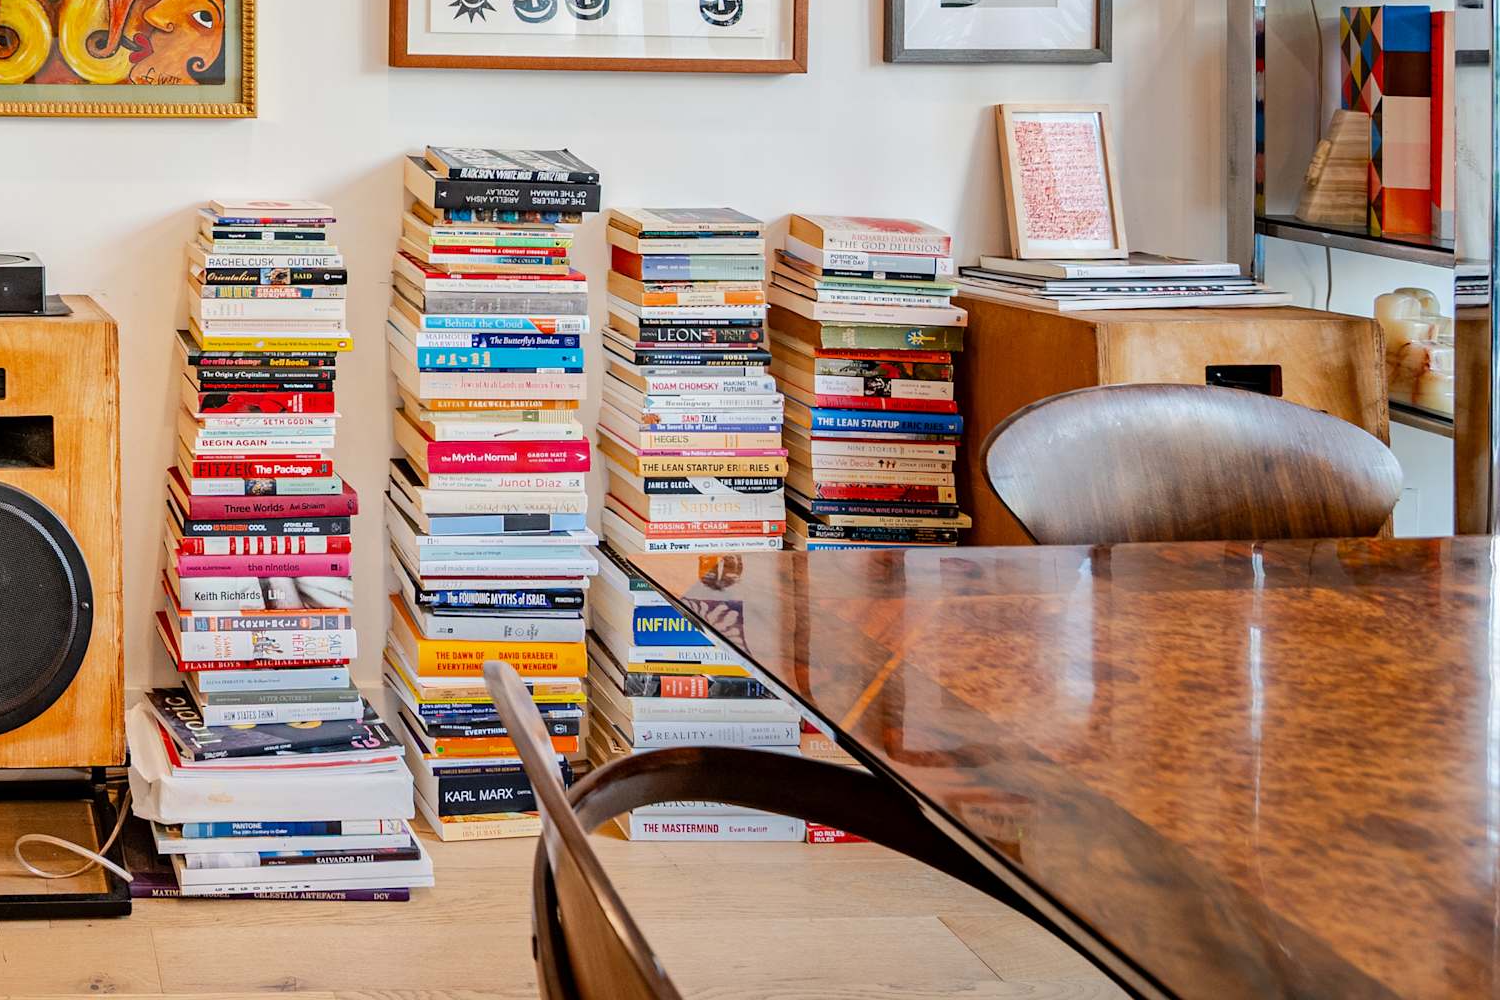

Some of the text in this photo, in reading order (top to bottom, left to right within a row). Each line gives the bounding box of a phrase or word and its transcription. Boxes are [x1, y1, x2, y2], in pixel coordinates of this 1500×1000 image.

[460, 168, 476, 178] BLACK
[494, 170, 517, 180] WHITE
[530, 189, 558, 197] UMMAH
[487, 196, 519, 204] ARIELLA
[839, 240, 941, 252] THE GOD DELUSION
[209, 257, 329, 267] RACHEL CUSK OUTLINE
[207, 270, 313, 282] Orientalism SAID
[445, 318, 523, 328] Behind the Cloud
[657, 328, 702, 341] LEON
[490, 336, 560, 346] The Butterfly's Burden
[215, 371, 233, 379] Origin
[241, 371, 270, 379] Capitalism
[652, 382, 677, 391] NOAM
[679, 382, 718, 391] CHOMSKY
[682, 415, 717, 423] SAND TALK
[817, 416, 944, 431] THE LEAN STARTUP ERIC RIES
[202, 439, 233, 447] BEGIN
[236, 439, 267, 447] AGAIN
[868, 445, 897, 453] STORIES
[452, 453, 477, 464] Myth
[484, 453, 518, 462] Normal
[817, 458, 875, 468] How We Decide
[199, 462, 313, 476] FITZEK The Package
[642, 463, 770, 472] THE LEAN STARTUP RIES
[498, 478, 531, 488] Junot
[647, 481, 669, 489] JAMES
[224, 504, 251, 513] Three
[253, 503, 284, 512] Worlds
[680, 498, 741, 515] Sapiens
[193, 524, 213, 532] GOOD
[248, 524, 267, 532] COOL
[649, 522, 728, 530] CROSSING THE CHASM
[649, 542, 668, 551] Black
[670, 542, 690, 550] Power
[248, 564, 300, 572] the nineties
[194, 590, 218, 601] Keith
[220, 590, 261, 601] Richards
[447, 592, 458, 604] The
[459, 592, 490, 605] FOUNDING
[490, 592, 518, 605] MYTHS
[518, 592, 525, 604] of
[526, 593, 547, 605] ISRAEL
[232, 618, 298, 629] BASKETBALL
[636, 617, 698, 633] INFINIT
[436, 652, 554, 660] THE DAWN OF DAVID GRAEBER
[185, 662, 215, 671] FLASH
[218, 661, 241, 669] BOYS
[256, 659, 299, 667] MICHAEL
[522, 663, 558, 671] WENGROW
[223, 712, 236, 721] HOW
[258, 710, 274, 719] THINK
[464, 727, 508, 736] EVERYTHING
[444, 789, 514, 803] KARL MARX
[232, 822, 262, 830] PANTONE
[643, 823, 660, 833] THE
[662, 823, 719, 833] MASTERMIND
[729, 825, 746, 833] Evan
[316, 856, 355, 864] SALVADOR
[300, 891, 346, 899] ARTEFACTS
